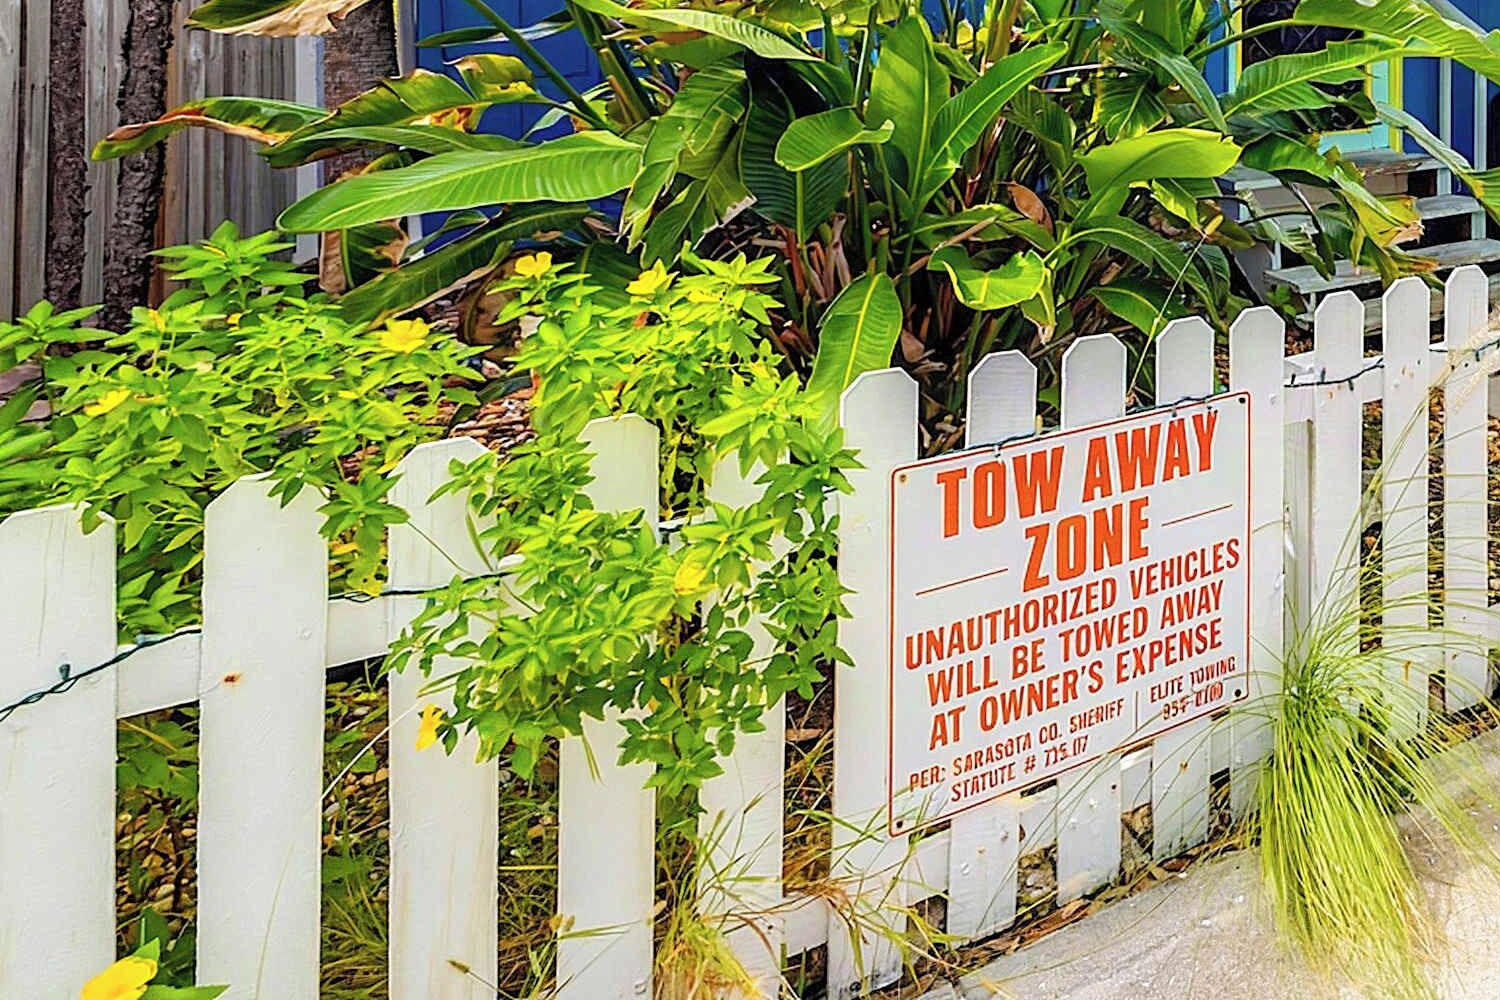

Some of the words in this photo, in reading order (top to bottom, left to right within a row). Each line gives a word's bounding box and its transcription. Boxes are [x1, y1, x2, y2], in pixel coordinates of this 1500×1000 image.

[937, 446, 1064, 537] TOW
[1082, 409, 1218, 502] AWAY
[1023, 497, 1149, 592] ZONE
[905, 578, 1117, 671] UNAUTHORIZED
[1130, 538, 1240, 600] VEHICLES
[927, 656, 998, 706] WILL
[1013, 637, 1045, 679] BE
[1059, 607, 1149, 663] TOWED
[1160, 580, 1224, 629] AWAY
[930, 707, 965, 750] AT
[980, 662, 1103, 731] OWNER'S
[1117, 618, 1222, 684] EXPENSE
[1150, 682, 1184, 703] ELITE
[1190, 657, 1235, 689] TOWING
[909, 767, 946, 791] PER:
[953, 736, 1032, 776] SARASOTA
[1039, 722, 1062, 743] CO.
[1070, 698, 1125, 732] SHERIFF
[951, 762, 1016, 801] STATUTE
[1024, 756, 1036, 773] #
